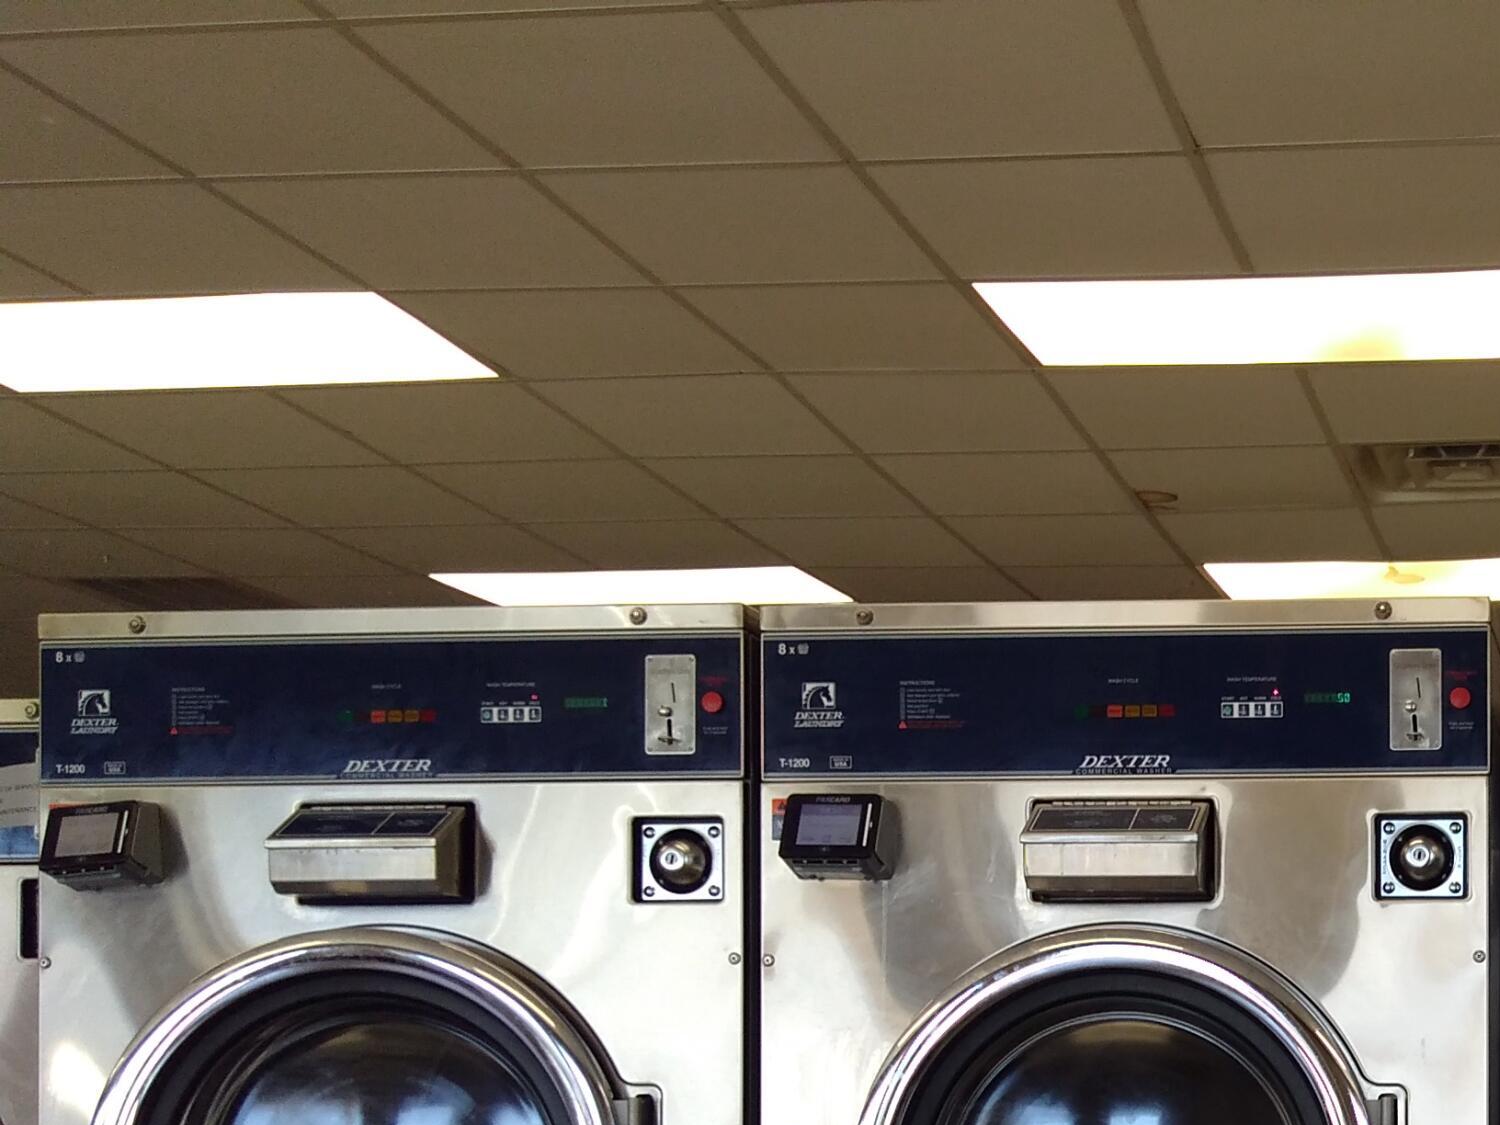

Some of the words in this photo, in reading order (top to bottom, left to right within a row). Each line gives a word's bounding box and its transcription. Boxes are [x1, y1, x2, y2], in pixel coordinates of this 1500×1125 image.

[777, 643, 786, 655] 8
[55, 651, 63, 663] 8
[794, 711, 843, 720] DEXTER
[71, 718, 117, 727] DEXTER
[343, 759, 432, 773] DEXTER
[779, 758, 810, 768] T-1200
[1079, 754, 1170, 768] DEXTER
[55, 764, 86, 774] T-1200
